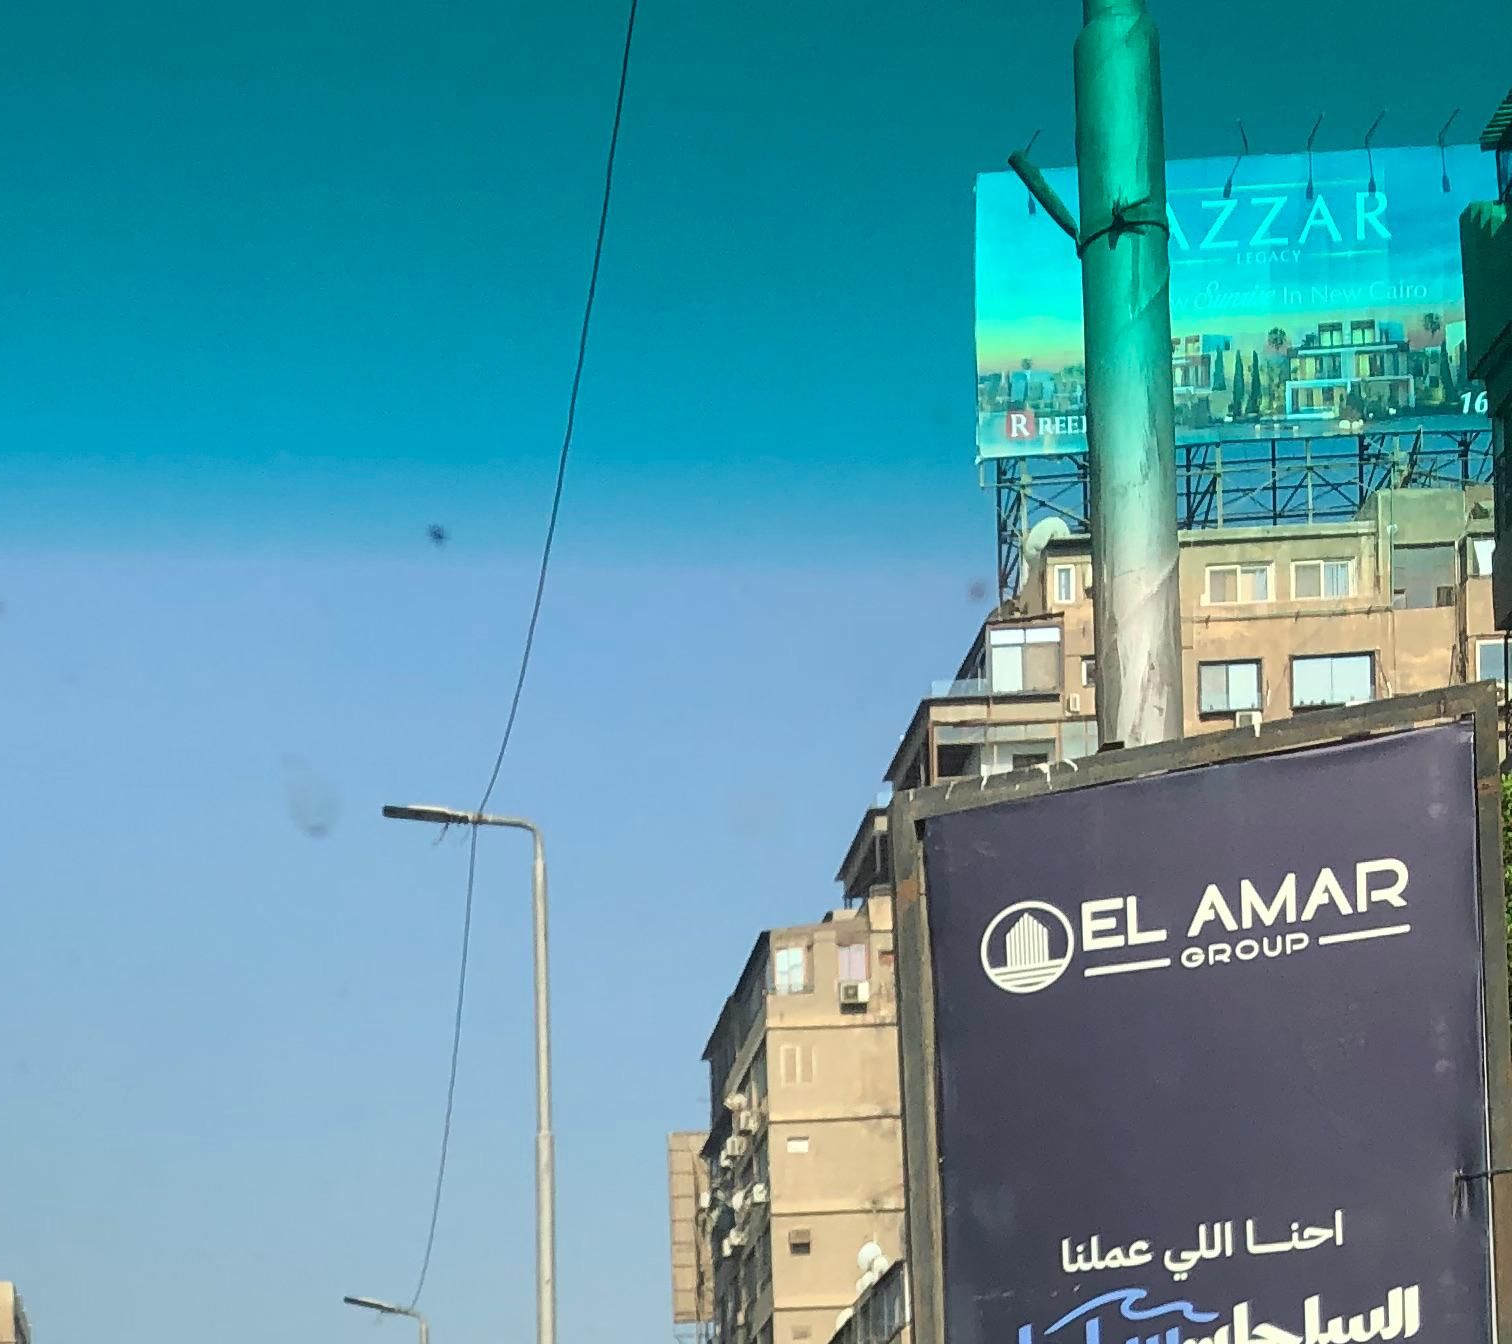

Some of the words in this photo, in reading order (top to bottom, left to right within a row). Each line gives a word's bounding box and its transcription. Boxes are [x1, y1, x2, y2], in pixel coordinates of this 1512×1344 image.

[1236, 249, 1302, 265] LEGACY
[1282, 287, 1303, 305] In
[1310, 286, 1363, 305] New
[1369, 280, 1428, 302] Cairo
[1081, 895, 1167, 953] EL
[1186, 856, 1410, 937] AMAR
[1180, 931, 1310, 969] GROUP
[1060, 1236, 1154, 1274] عملنا
[1163, 1221, 1233, 1282] اللي
